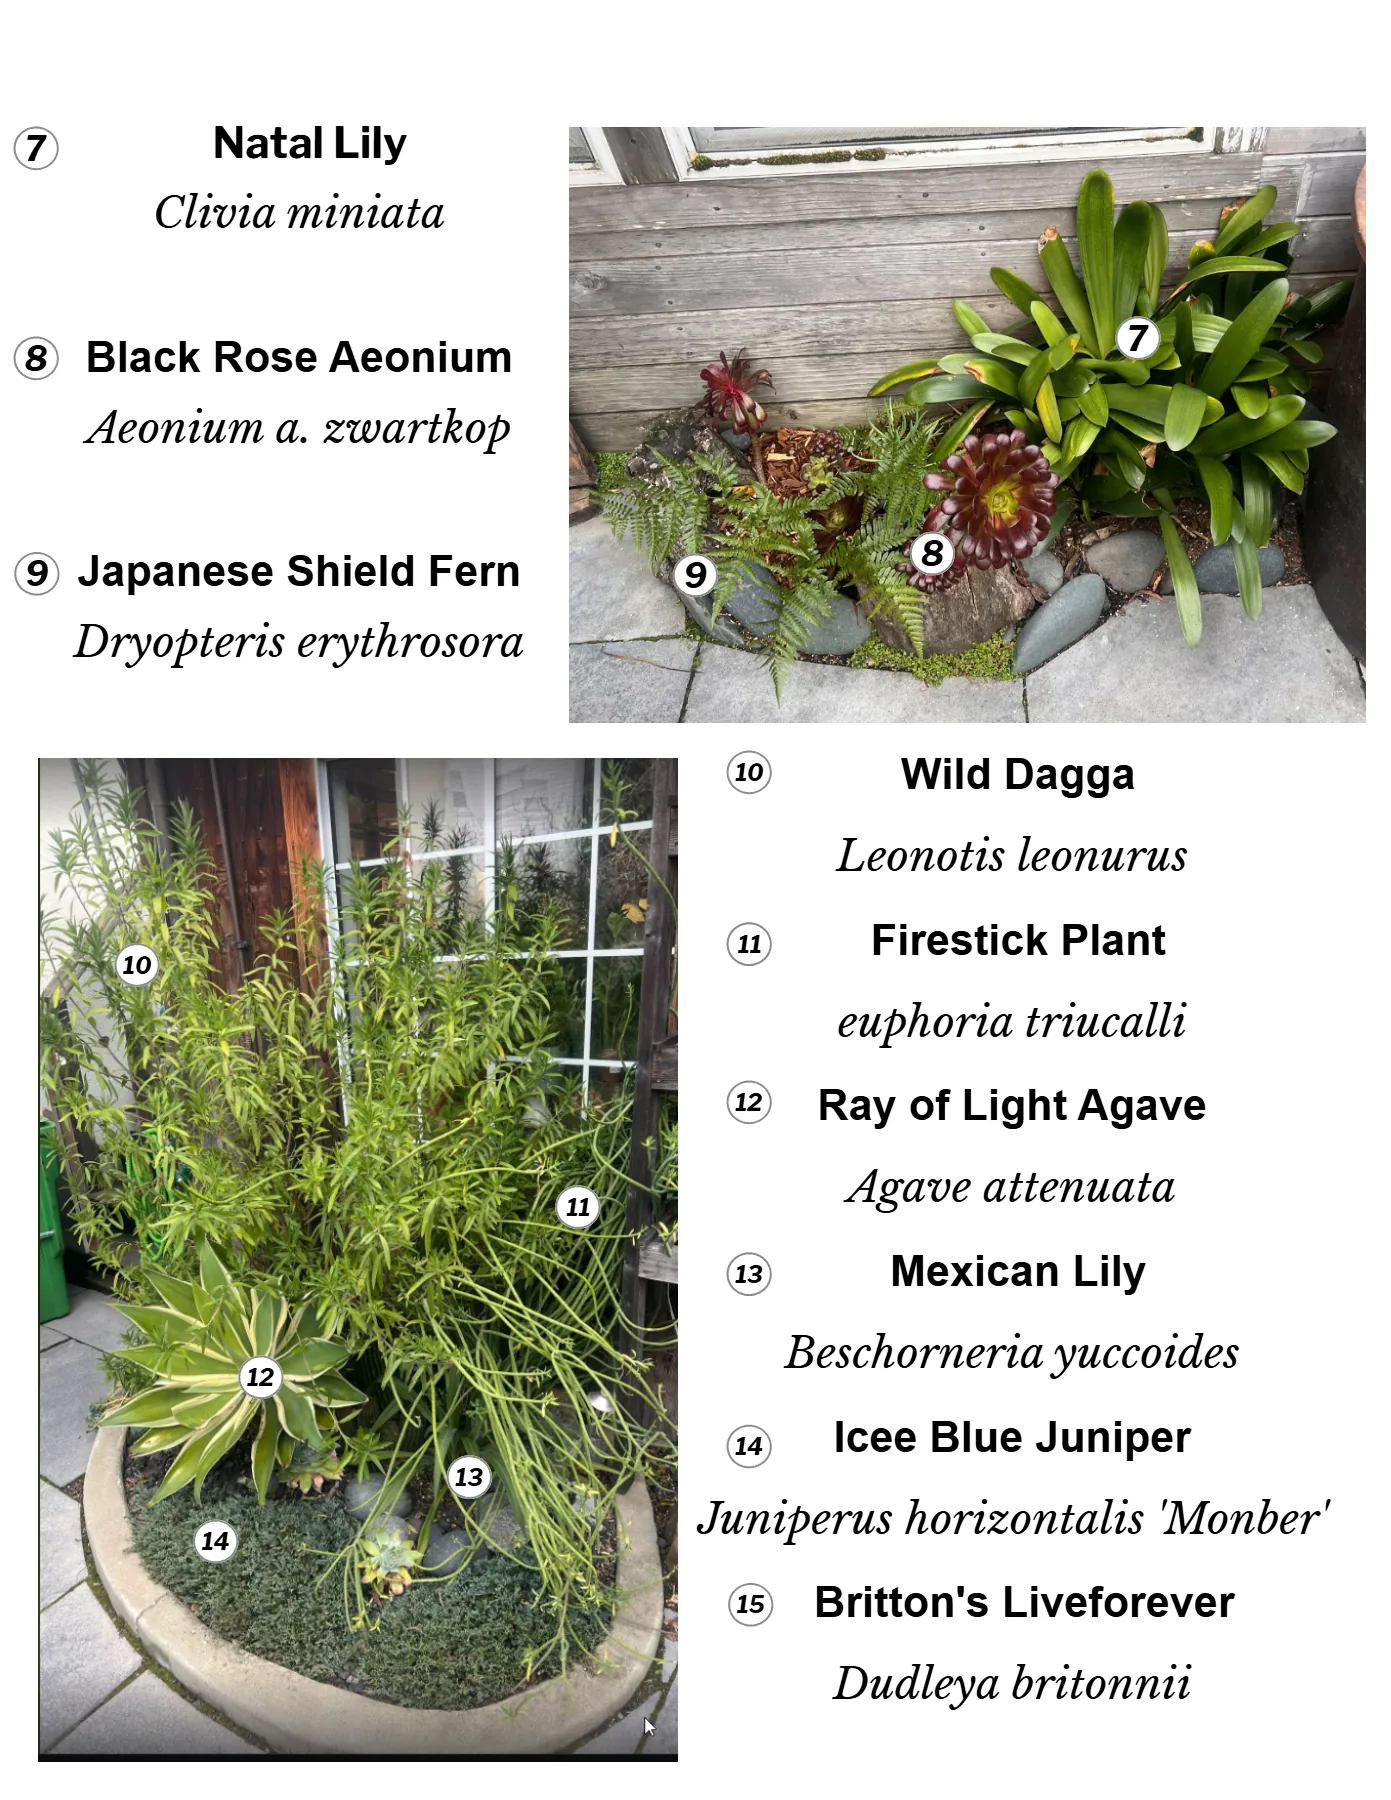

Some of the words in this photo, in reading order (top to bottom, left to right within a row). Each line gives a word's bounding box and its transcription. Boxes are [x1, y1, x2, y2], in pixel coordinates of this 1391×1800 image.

[27, 134, 47, 162] 7
[214, 125, 323, 160] Natal
[335, 125, 408, 166] Lily
[155, 192, 276, 229] Clivia
[286, 192, 445, 229] miniata
[25, 344, 48, 372] 8
[87, 340, 201, 373] Black
[215, 340, 318, 373] Rose
[328, 340, 511, 373] Aeonium
[82, 407, 265, 444] Aeonium
[275, 419, 307, 444] a.
[322, 407, 511, 455] zwartkop
[26, 559, 49, 587] 9
[77, 554, 274, 596] Japanese
[287, 554, 414, 587] Shield
[430, 554, 519, 587] Fern
[72, 621, 286, 669] Dryopteris
[297, 621, 524, 669] erythrosora
[735, 762, 764, 782] 10
[900, 757, 990, 790] Wild
[1006, 757, 1135, 799] Dagga
[835, 835, 1006, 872] Leonotis
[1018, 835, 1188, 872] leonurus
[737, 934, 761, 954] 11
[873, 923, 1049, 956] Firestick
[1062, 923, 1166, 956] Plant
[838, 1001, 1014, 1049] euphoria
[1026, 1001, 1188, 1038] triucalli
[735, 1092, 763, 1112] 12
[819, 1088, 897, 1130] Ray
[910, 1088, 952, 1121] of
[964, 1088, 1068, 1130] Light
[1077, 1088, 1206, 1130] Agave
[842, 1168, 972, 1214] Agave
[983, 1172, 1176, 1203] attenuata
[735, 1264, 763, 1284] 13
[892, 1254, 1058, 1287] Mexican
[1075, 1254, 1147, 1296] Lily
[783, 1332, 1044, 1369] Beschorneria
[1049, 1332, 1240, 1380] yuccoides
[735, 1436, 763, 1456] 14
[835, 1420, 917, 1453] Icee
[931, 1420, 1023, 1453] Blue
[1035, 1420, 1193, 1462] Juniper
[696, 1498, 893, 1546] Juniperus
[904, 1498, 1145, 1535] horizontalis
[1161, 1498, 1332, 1535] 'Monber'
[736, 1594, 765, 1614] 15
[816, 1585, 989, 1618] Britton's
[1004, 1585, 1236, 1618] Liveforever
[831, 1663, 1000, 1711] Dudleya
[1012, 1663, 1192, 1700] britonnii
